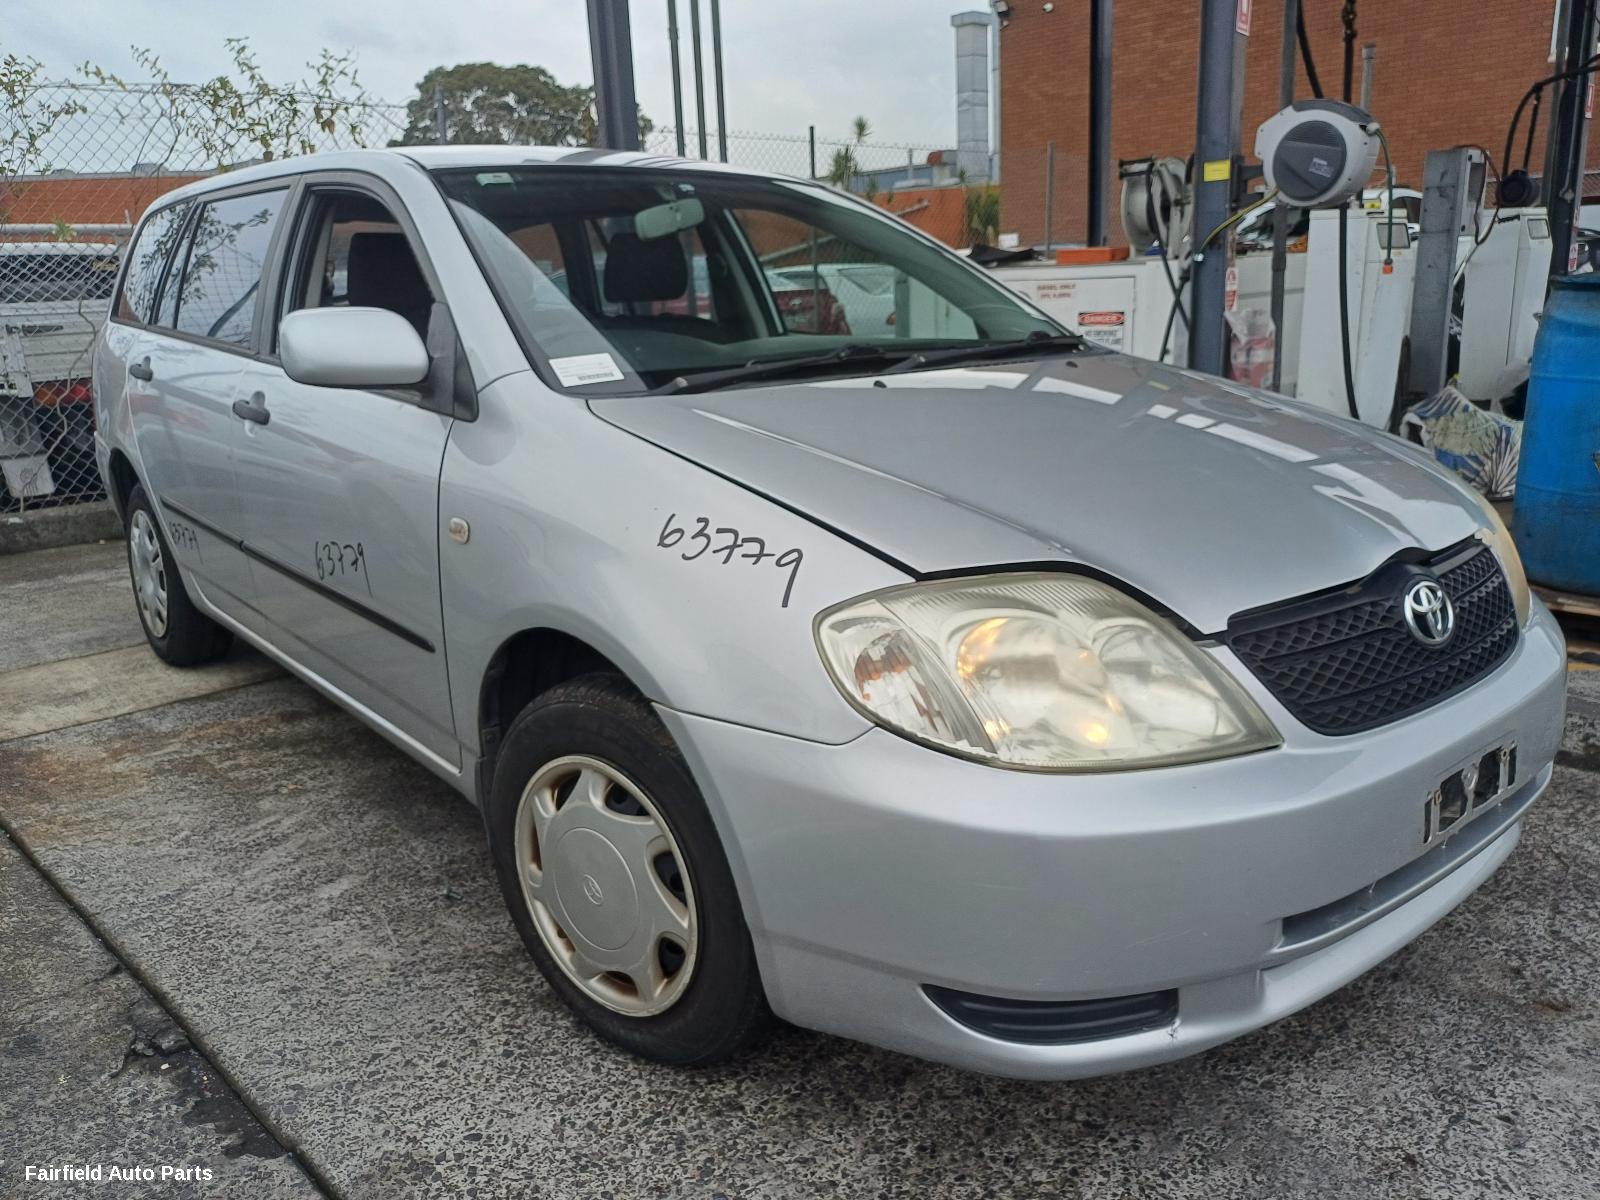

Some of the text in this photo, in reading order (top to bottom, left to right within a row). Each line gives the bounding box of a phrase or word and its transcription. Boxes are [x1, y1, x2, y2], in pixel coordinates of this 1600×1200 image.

[1085, 314, 1117, 323] DANGER
[315, 541, 373, 598] 63779
[656, 513, 804, 608] 63779
